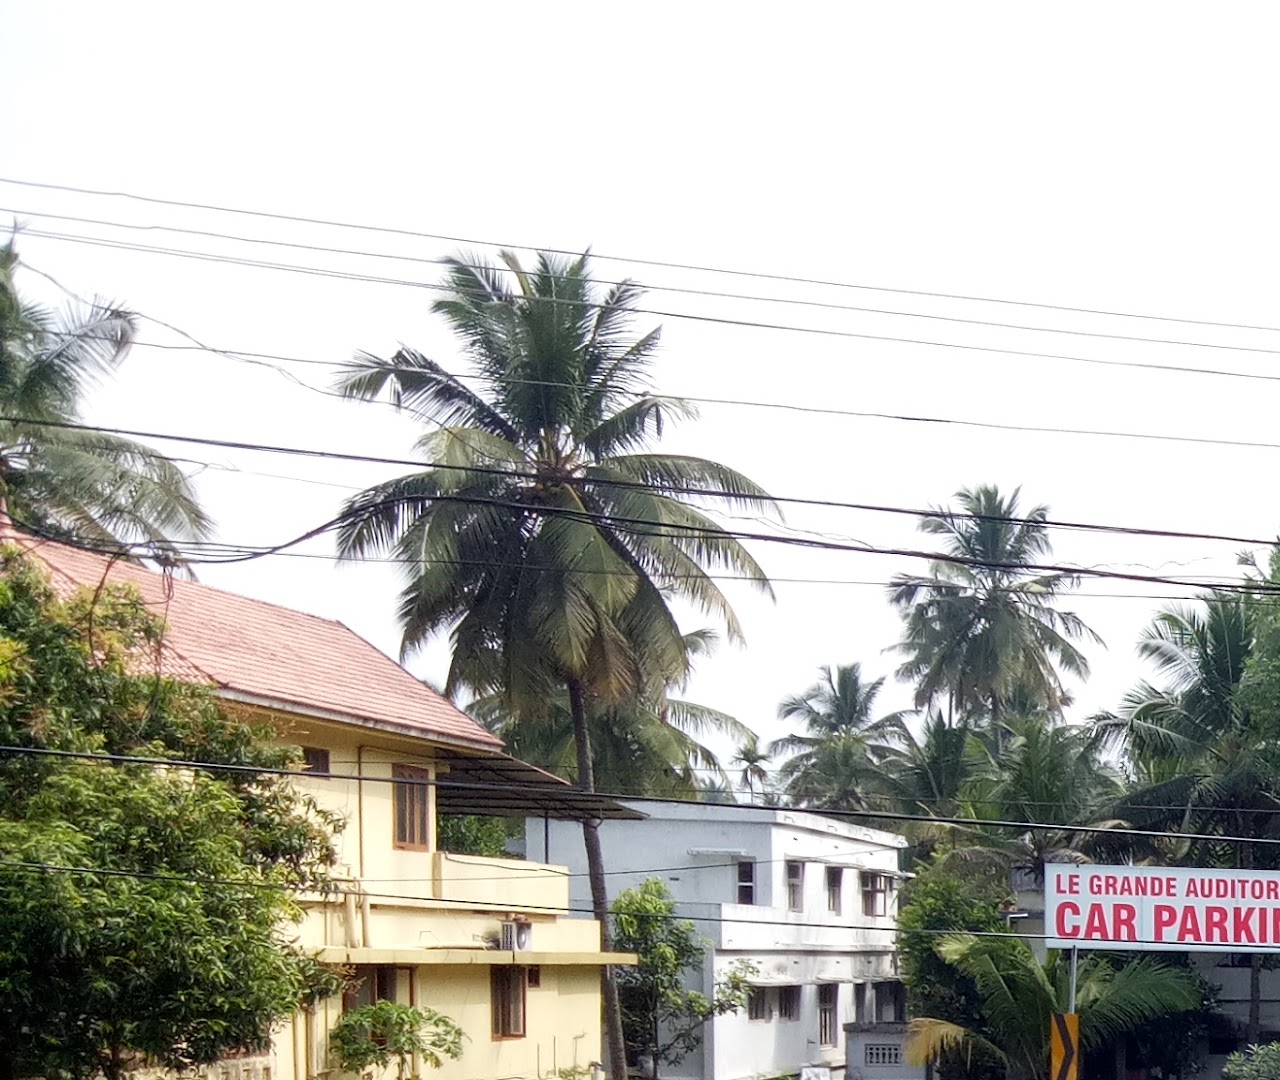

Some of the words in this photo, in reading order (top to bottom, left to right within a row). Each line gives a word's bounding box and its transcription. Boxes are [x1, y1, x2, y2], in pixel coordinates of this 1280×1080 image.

[1056, 874, 1080, 895] LE
[1089, 875, 1177, 897] GRANDE
[1056, 901, 1137, 941] CAR
